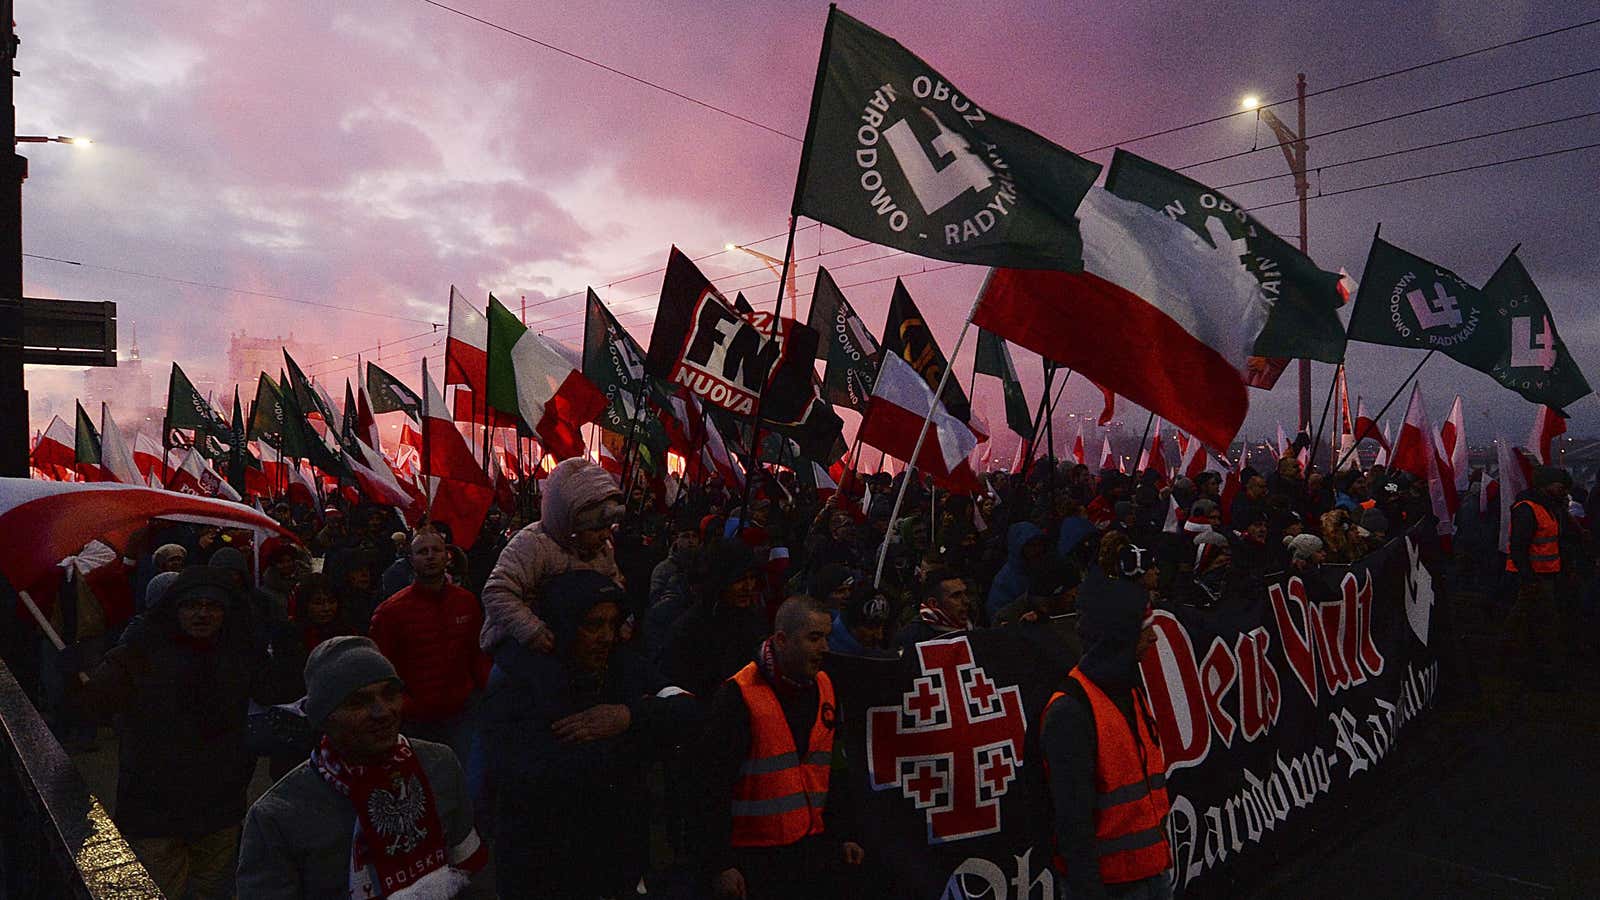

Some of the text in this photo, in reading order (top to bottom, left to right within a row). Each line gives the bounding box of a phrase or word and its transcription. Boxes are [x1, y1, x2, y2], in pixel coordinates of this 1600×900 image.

[1390, 271, 1417, 337] NARODOWO
[1429, 306, 1480, 346] RADYKALNY
[674, 366, 753, 415] NUOVA
[1137, 568, 1384, 779] Deus Vult
[385, 849, 446, 888] POLSKA
